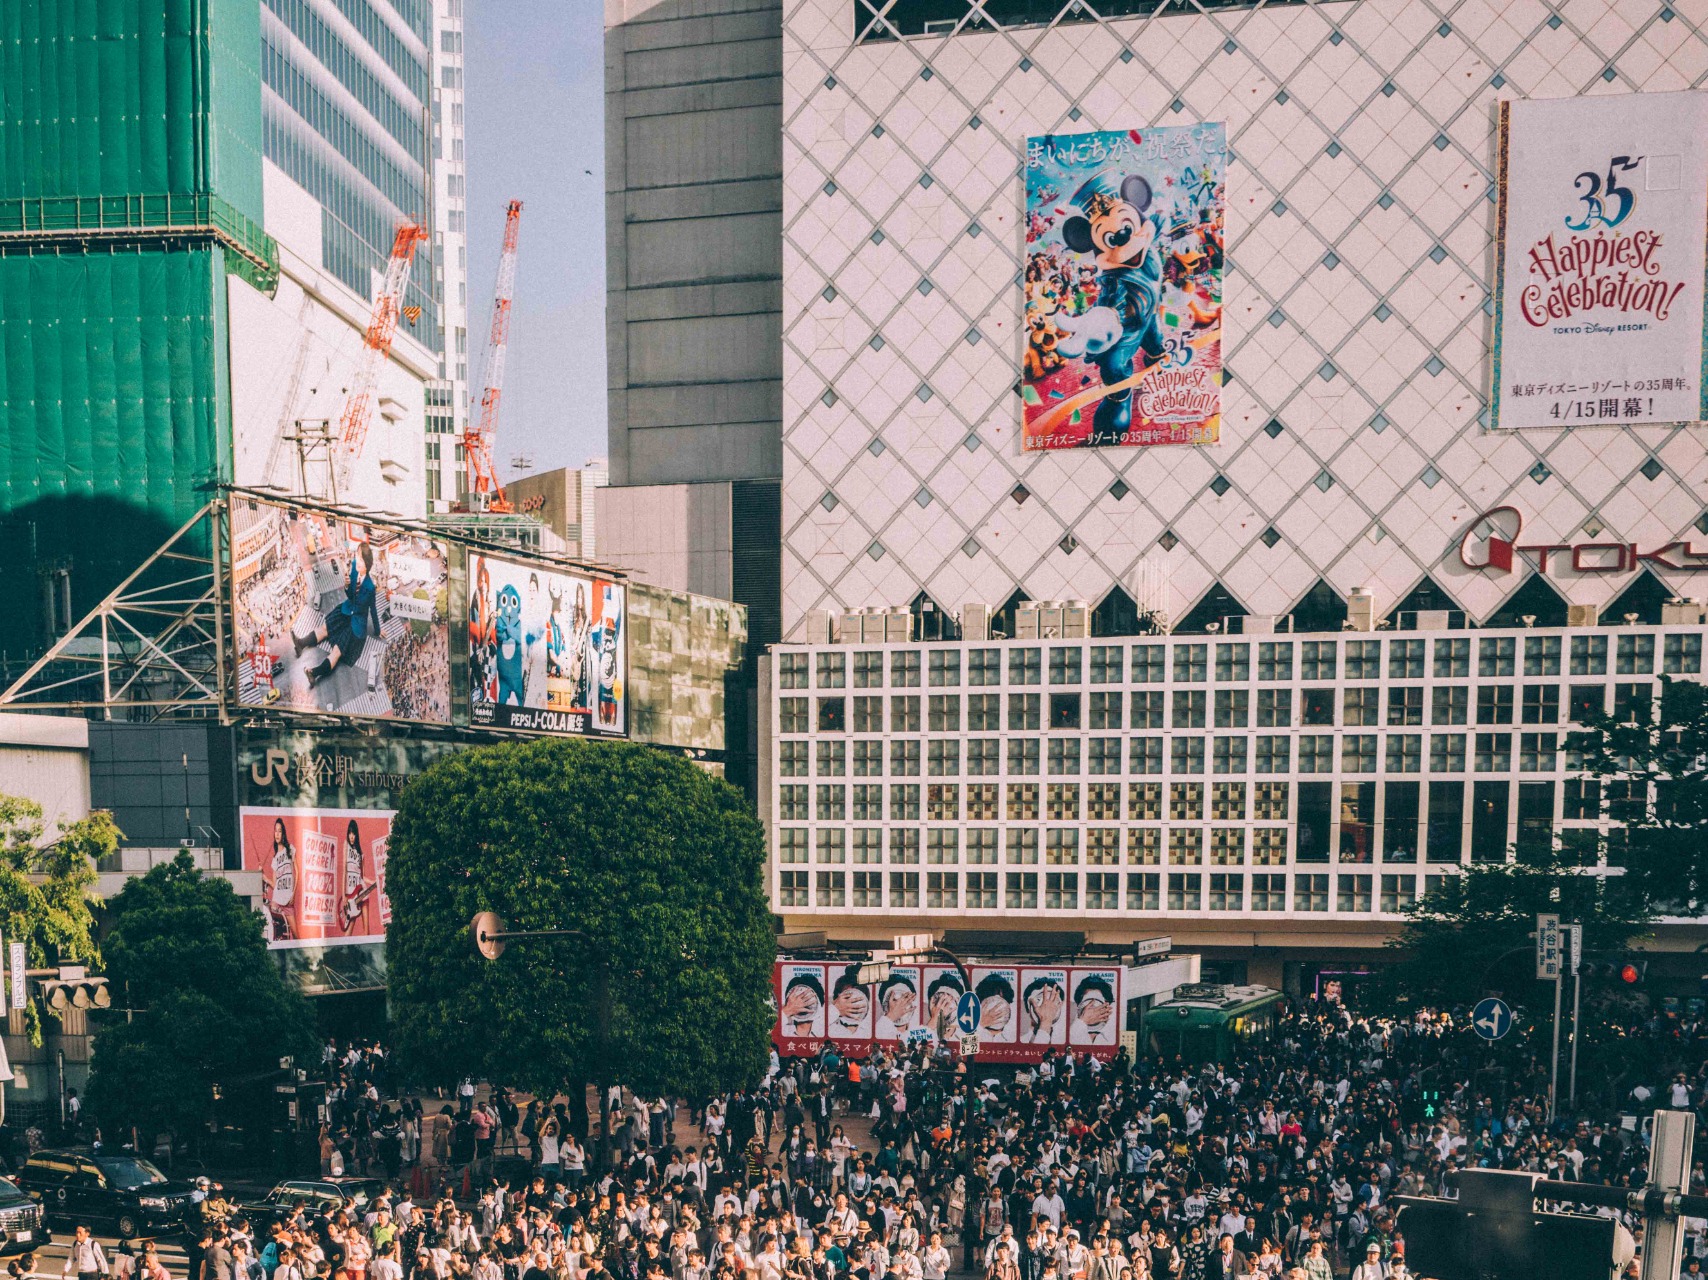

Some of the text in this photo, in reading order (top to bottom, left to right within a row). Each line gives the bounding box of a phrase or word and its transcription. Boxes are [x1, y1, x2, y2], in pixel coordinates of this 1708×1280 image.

[1028, 129, 1226, 168] まいにちが、祝祭だ。
[1565, 156, 1645, 231] 35
[1528, 231, 1663, 283] Happiest
[1520, 270, 1685, 327] Celebration!
[1582, 322, 1615, 335] Disney
[1160, 331, 1197, 368] 35
[1143, 368, 1207, 393] Happiest
[1511, 377, 1691, 397] 東京ディズニーリゾートの35周年。
[1140, 389, 1218, 417] Celebration!
[1550, 397, 1654, 420] 4/15開幕!
[255, 655, 271, 674] 50
[510, 713, 531, 727] PEPSI
[531, 711, 567, 731] J-COLA
[252, 749, 404, 790] JR 渋谷駅 shibuya
[1546, 919, 1556, 974] 渋谷駅前
[907, 1034, 932, 1042] ABUM
[961, 1043, 978, 1055] 8-22
